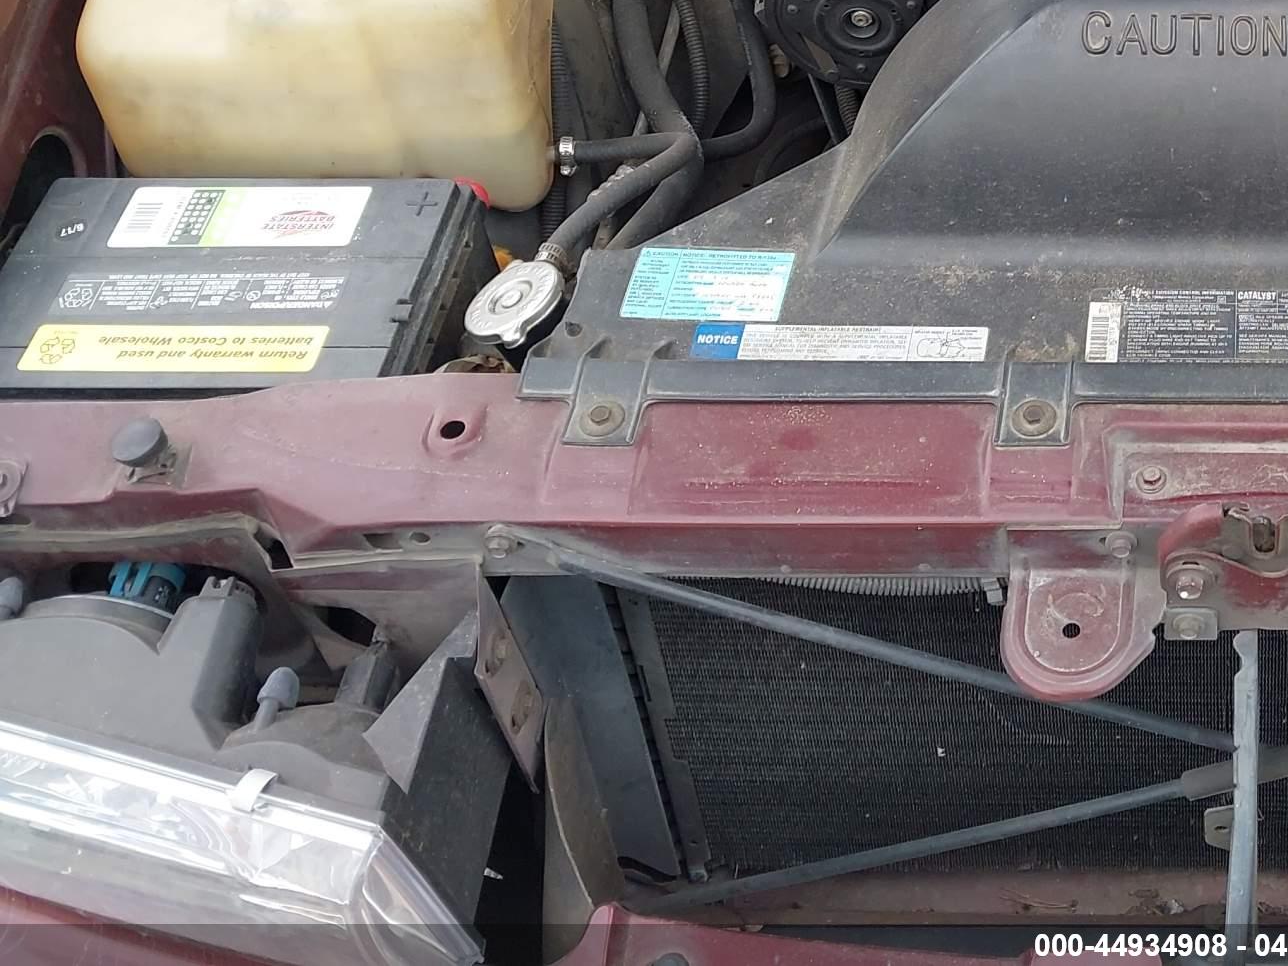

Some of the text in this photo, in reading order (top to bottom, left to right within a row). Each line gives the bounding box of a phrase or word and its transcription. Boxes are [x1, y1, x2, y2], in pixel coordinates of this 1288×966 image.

[1081, 10, 1288, 56] CAUTION
[271, 215, 336, 223] BATTERIES
[60, 222, 85, 237] 6/17
[262, 222, 336, 231] INTERSTATE
[1237, 291, 1277, 301] CATALYST
[98, 336, 314, 346] batteries to Costco Wholesale
[697, 334, 739, 345] NOTICE
[116, 349, 309, 360] Return warranty and used
